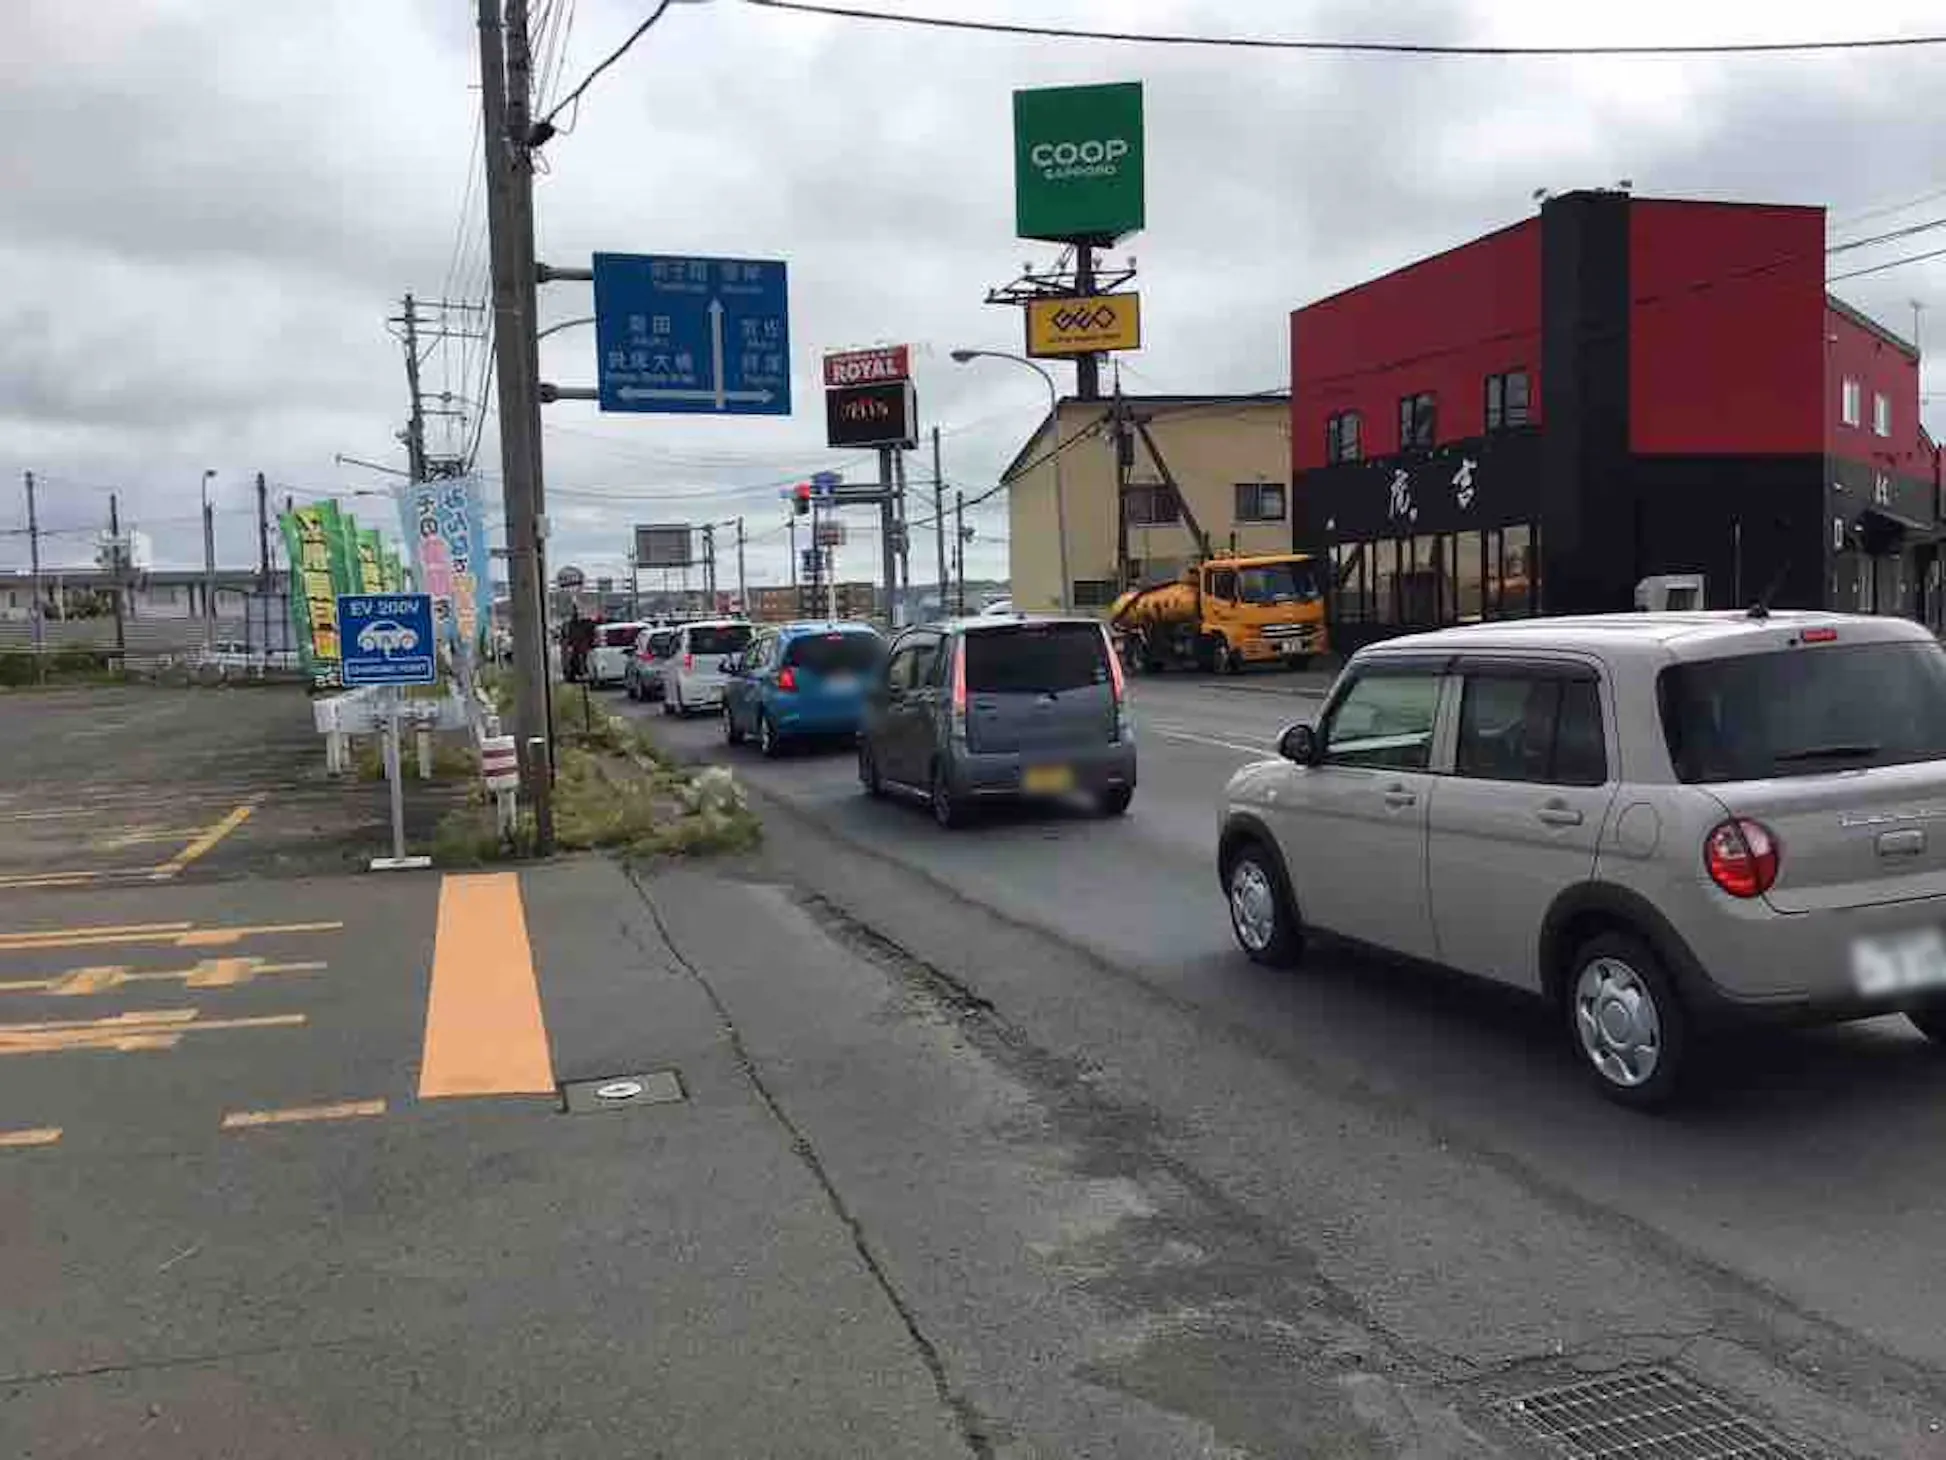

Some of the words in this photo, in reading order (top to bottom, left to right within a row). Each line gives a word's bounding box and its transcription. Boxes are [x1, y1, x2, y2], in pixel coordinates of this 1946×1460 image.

[1032, 139, 1128, 166] COOP
[832, 358, 898, 384] ROYAL
[350, 600, 373, 616] EV
